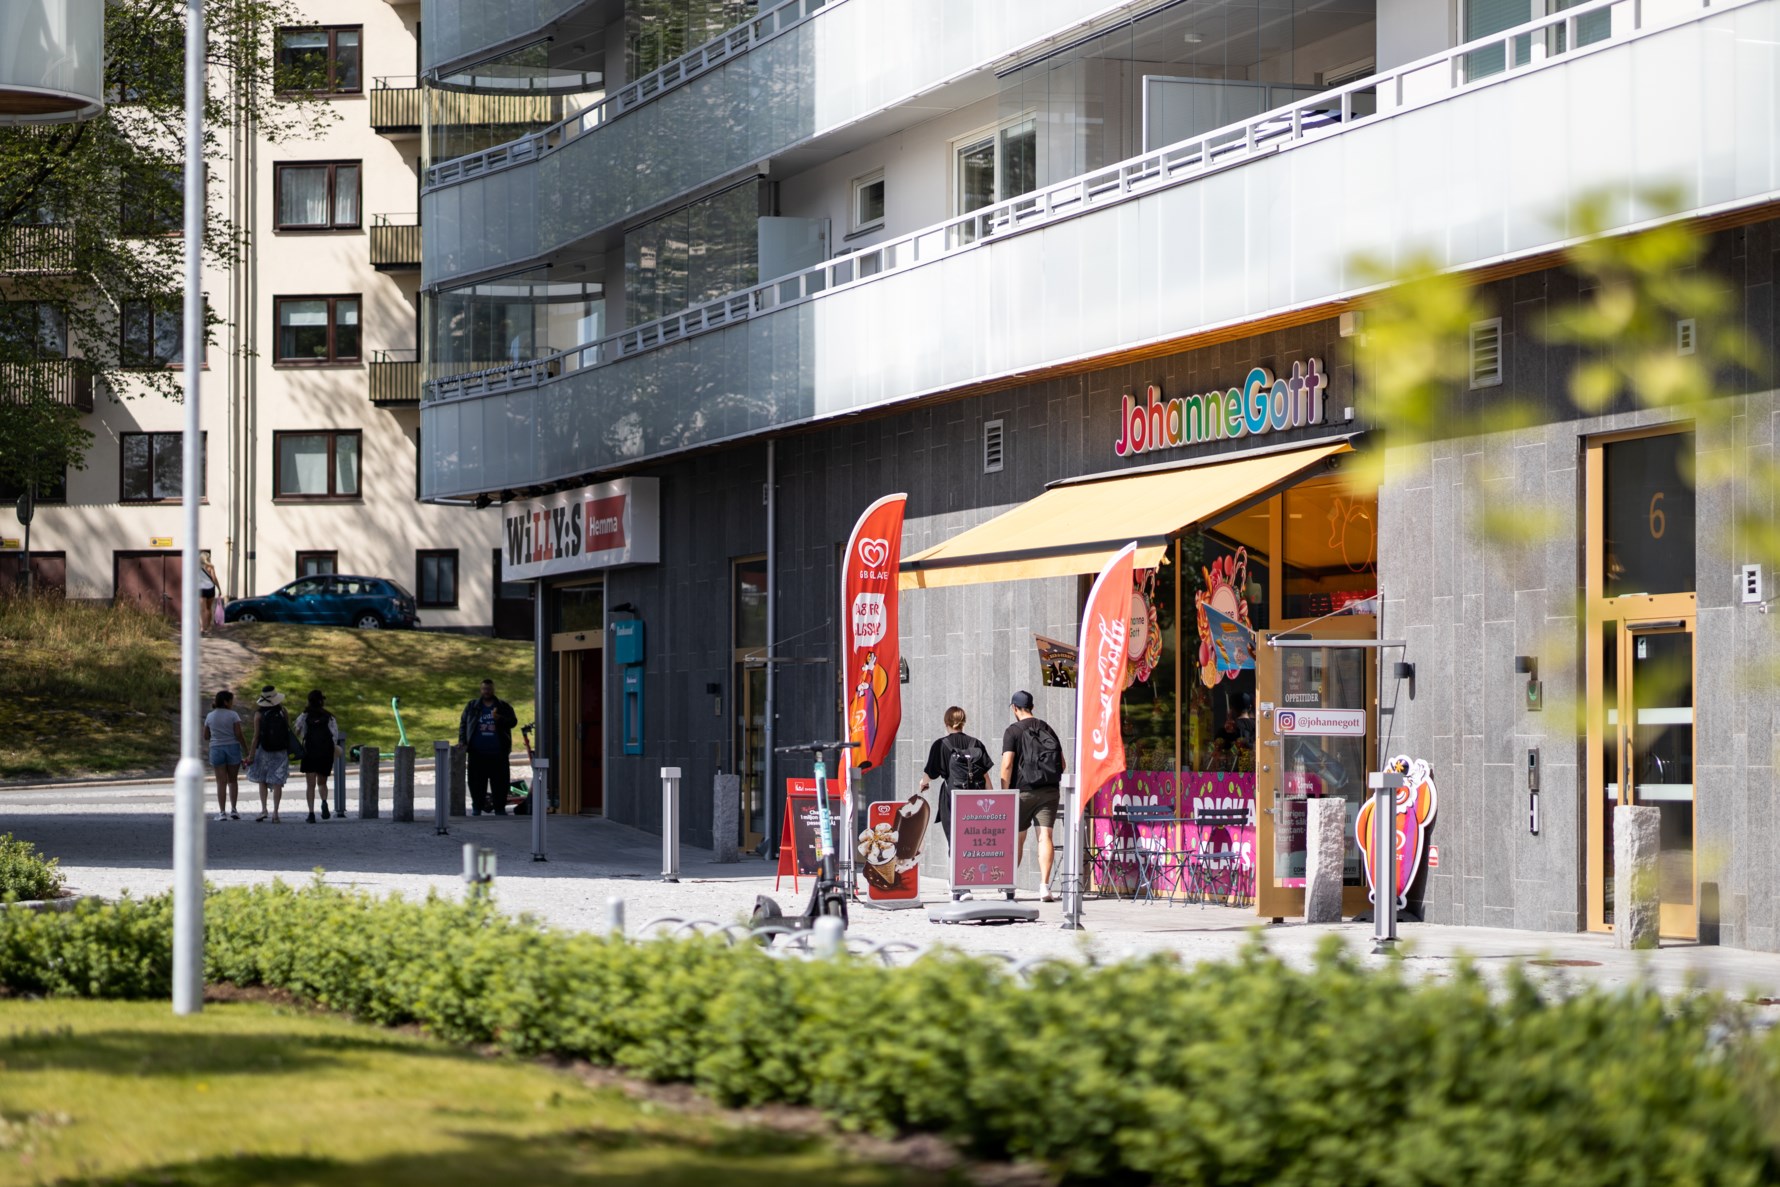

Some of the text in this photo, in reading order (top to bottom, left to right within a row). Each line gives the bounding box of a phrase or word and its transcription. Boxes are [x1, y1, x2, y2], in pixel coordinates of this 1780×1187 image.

[1115, 357, 1327, 457] JohanneGott
[1649, 491, 1666, 540] 6
[589, 515, 618, 537] Hemma
[1298, 717, 1360, 729] @johannegott
[964, 827, 1005, 836] Alla dagar
[973, 838, 997, 847] 11-21
